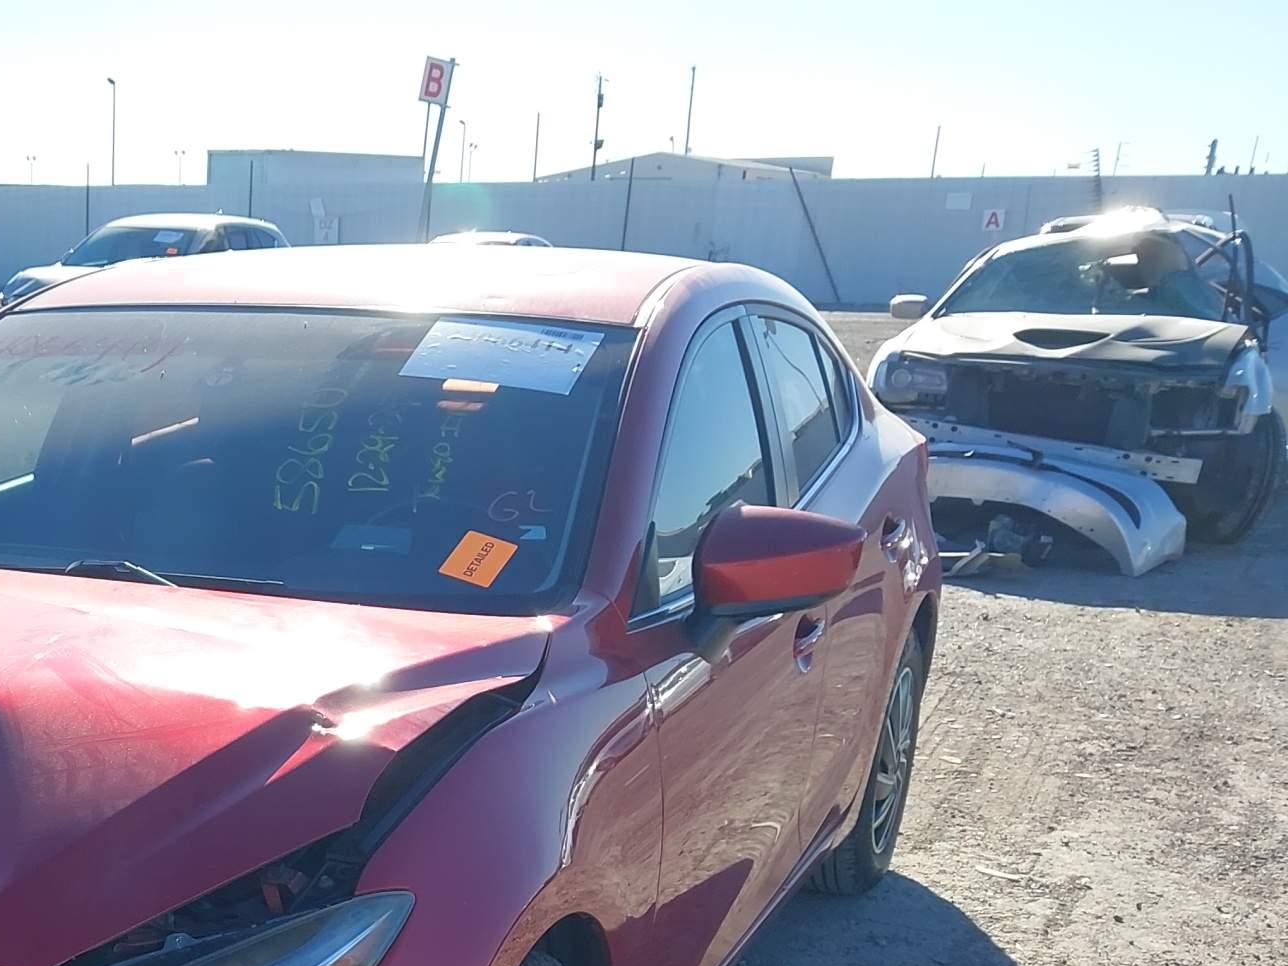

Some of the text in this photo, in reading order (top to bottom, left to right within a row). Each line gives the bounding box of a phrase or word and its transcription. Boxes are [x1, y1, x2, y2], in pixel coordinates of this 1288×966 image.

[424, 62, 444, 98] B
[985, 211, 1000, 229] A
[463, 541, 495, 577] DETAILED
